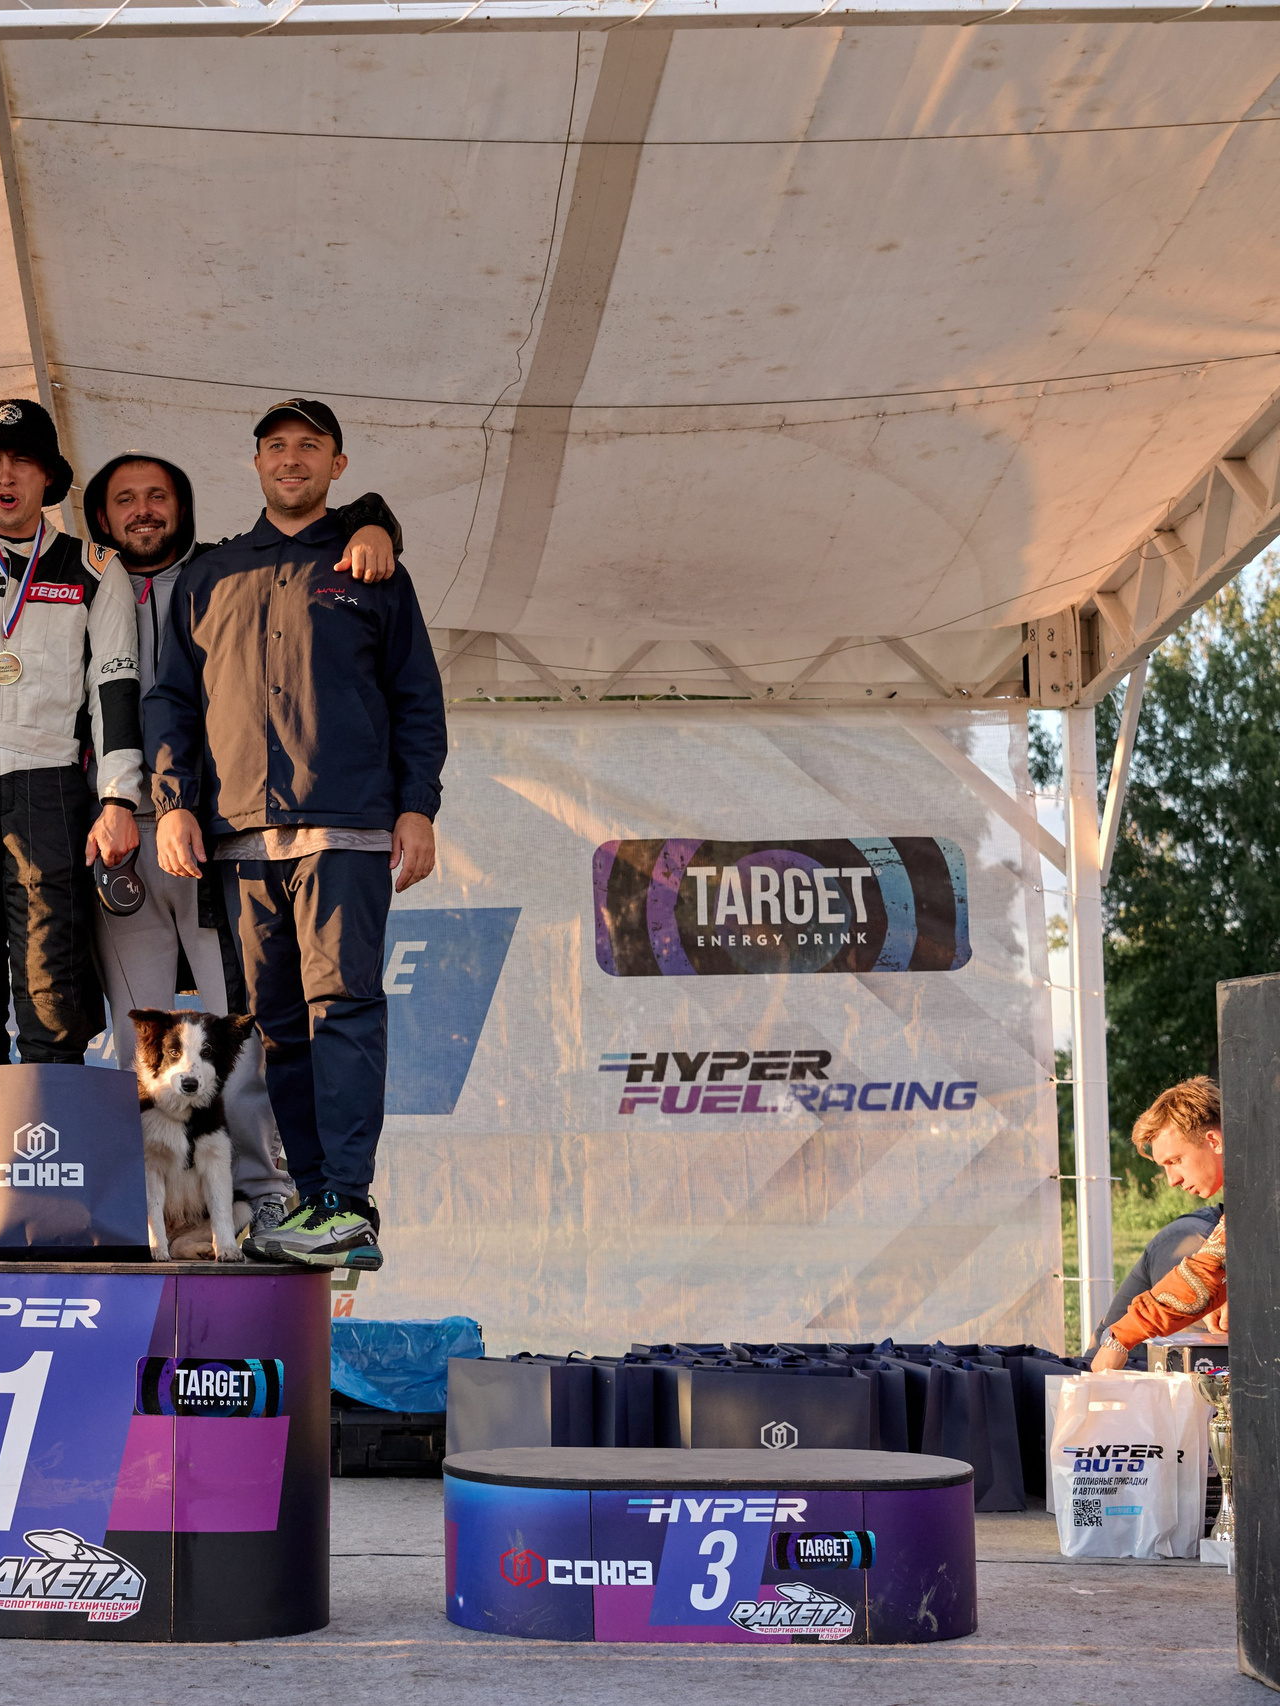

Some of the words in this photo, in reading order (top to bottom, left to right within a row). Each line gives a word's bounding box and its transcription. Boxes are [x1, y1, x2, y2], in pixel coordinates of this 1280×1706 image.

[30, 586, 80, 600] TEBOIL
[686, 865, 872, 926] TARGET
[697, 934, 783, 947] ENERGY
[797, 932, 868, 945] DRINK
[626, 1050, 832, 1083] HYPER
[781, 1081, 978, 1113] RACING
[175, 1369, 252, 1398] TARGET
[1074, 1444, 1164, 1460] HYPER
[1073, 1458, 1145, 1473] AUTO
[1072, 1477, 1113, 1486] ТОПЛИВНЫЕ
[1113, 1477, 1148, 1486] ПРИСАДКИ
[1072, 1487, 1077, 1495] И
[1078, 1487, 1118, 1495] АВТОХИМИЯ
[647, 1498, 808, 1523] HYPER
[797, 1538, 850, 1557] TARGET
[547, 1558, 654, 1586] СОЮЗ
[689, 1529, 738, 1612] 3
[3, 1600, 140, 1611] СПОРТИВНО-ТЕХНИЧЕСКИЙ
[90, 1611, 120, 1621] КЛУБ
[730, 1601, 854, 1628] РАКЕТА
[763, 1626, 852, 1634] СПОРТИВНО-ТЕХНИЧЕСКИЙ
